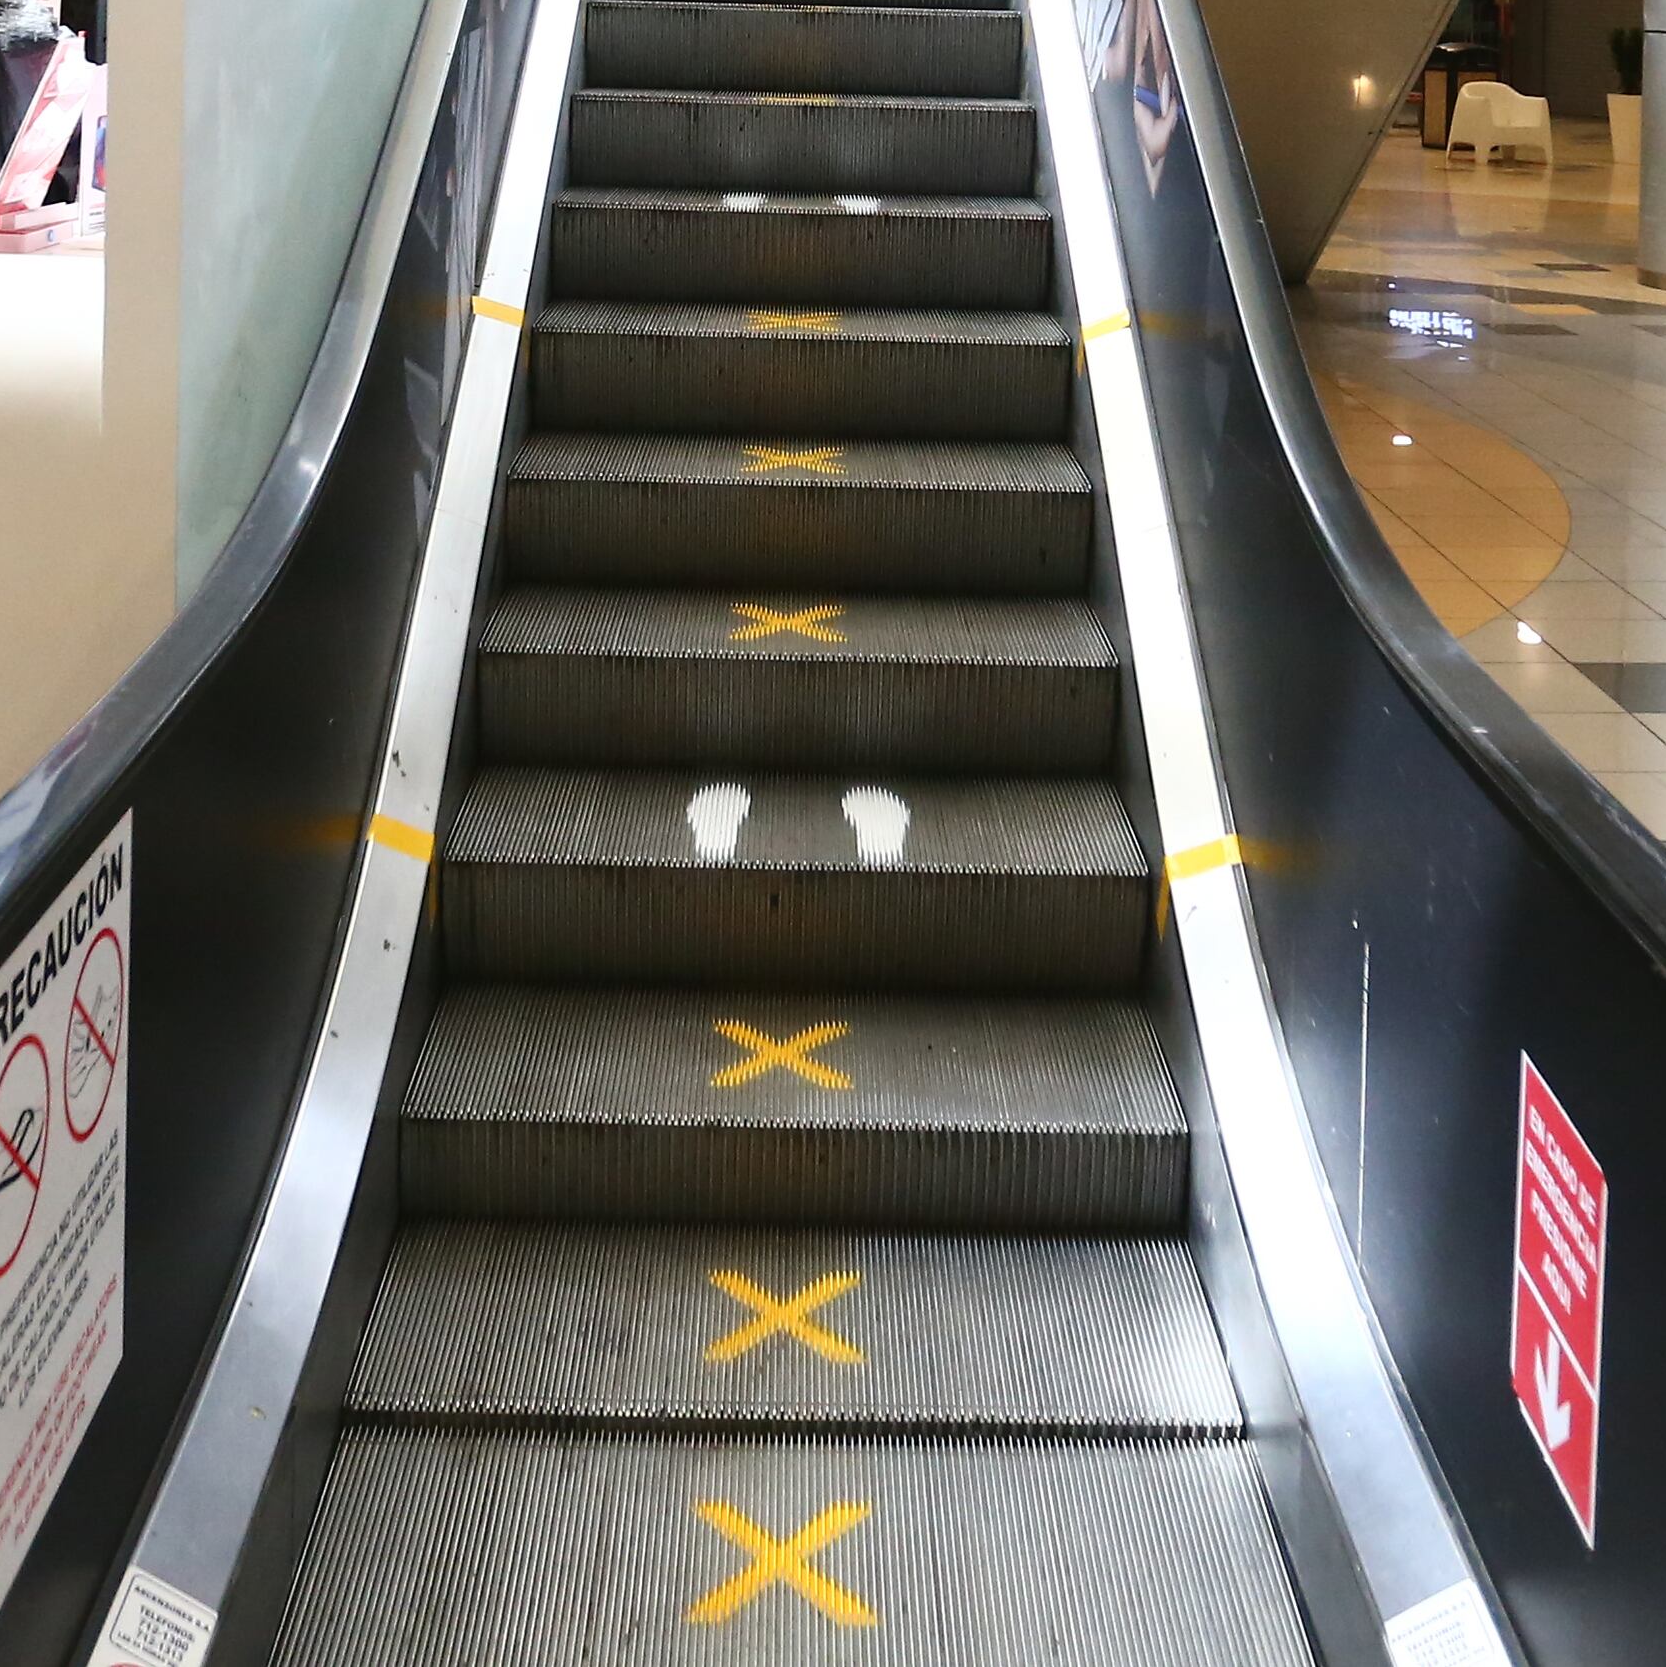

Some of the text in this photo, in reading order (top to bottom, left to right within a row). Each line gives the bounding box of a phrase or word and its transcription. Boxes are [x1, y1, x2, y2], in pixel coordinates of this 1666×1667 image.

[1524, 1136, 1597, 1275] EMERGENCIA
[1530, 1104, 1597, 1228] EN CASO DE
[1531, 1186, 1588, 1300] PRESIONE
